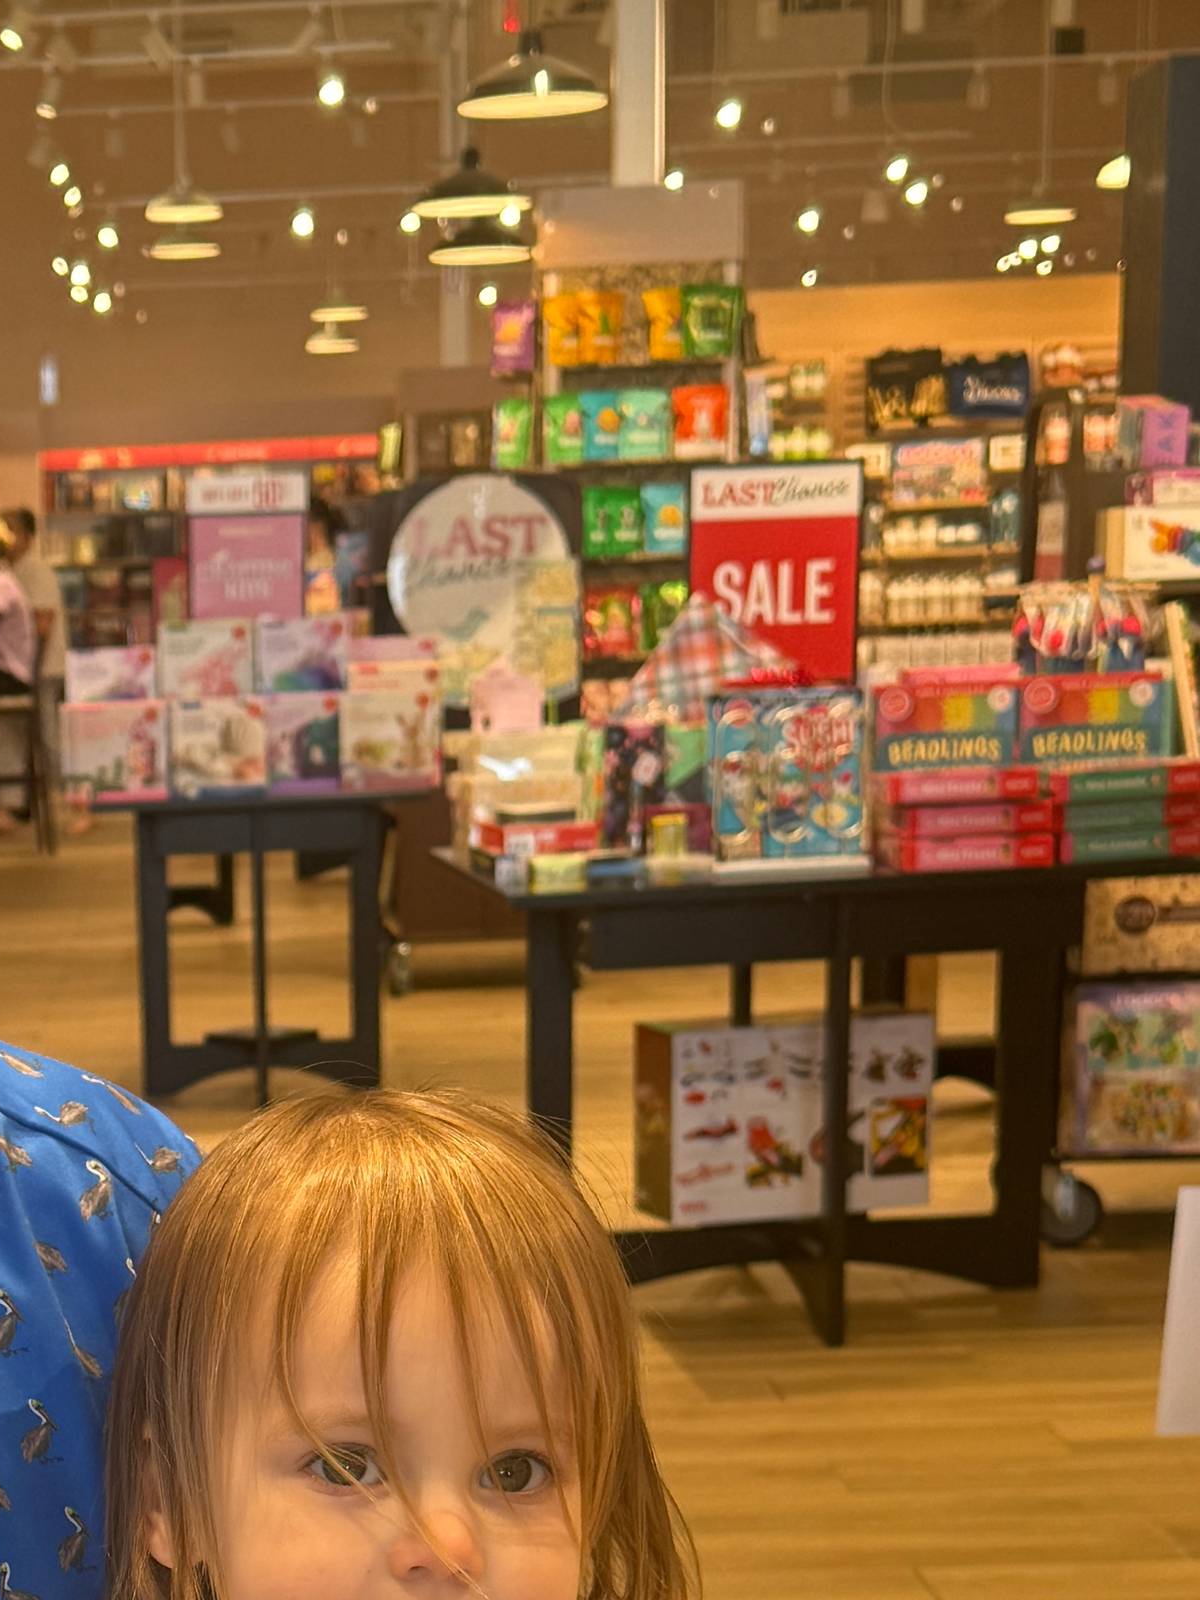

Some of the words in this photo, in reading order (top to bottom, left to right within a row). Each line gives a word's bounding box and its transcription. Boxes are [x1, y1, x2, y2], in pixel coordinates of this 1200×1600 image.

[702, 479, 775, 507] LAST
[771, 474, 850, 506] Chance
[412, 514, 548, 560] LAST
[712, 557, 836, 627] SALE
[888, 735, 1001, 766] BEADLINGS
[1032, 727, 1148, 759] BEADLINGS
